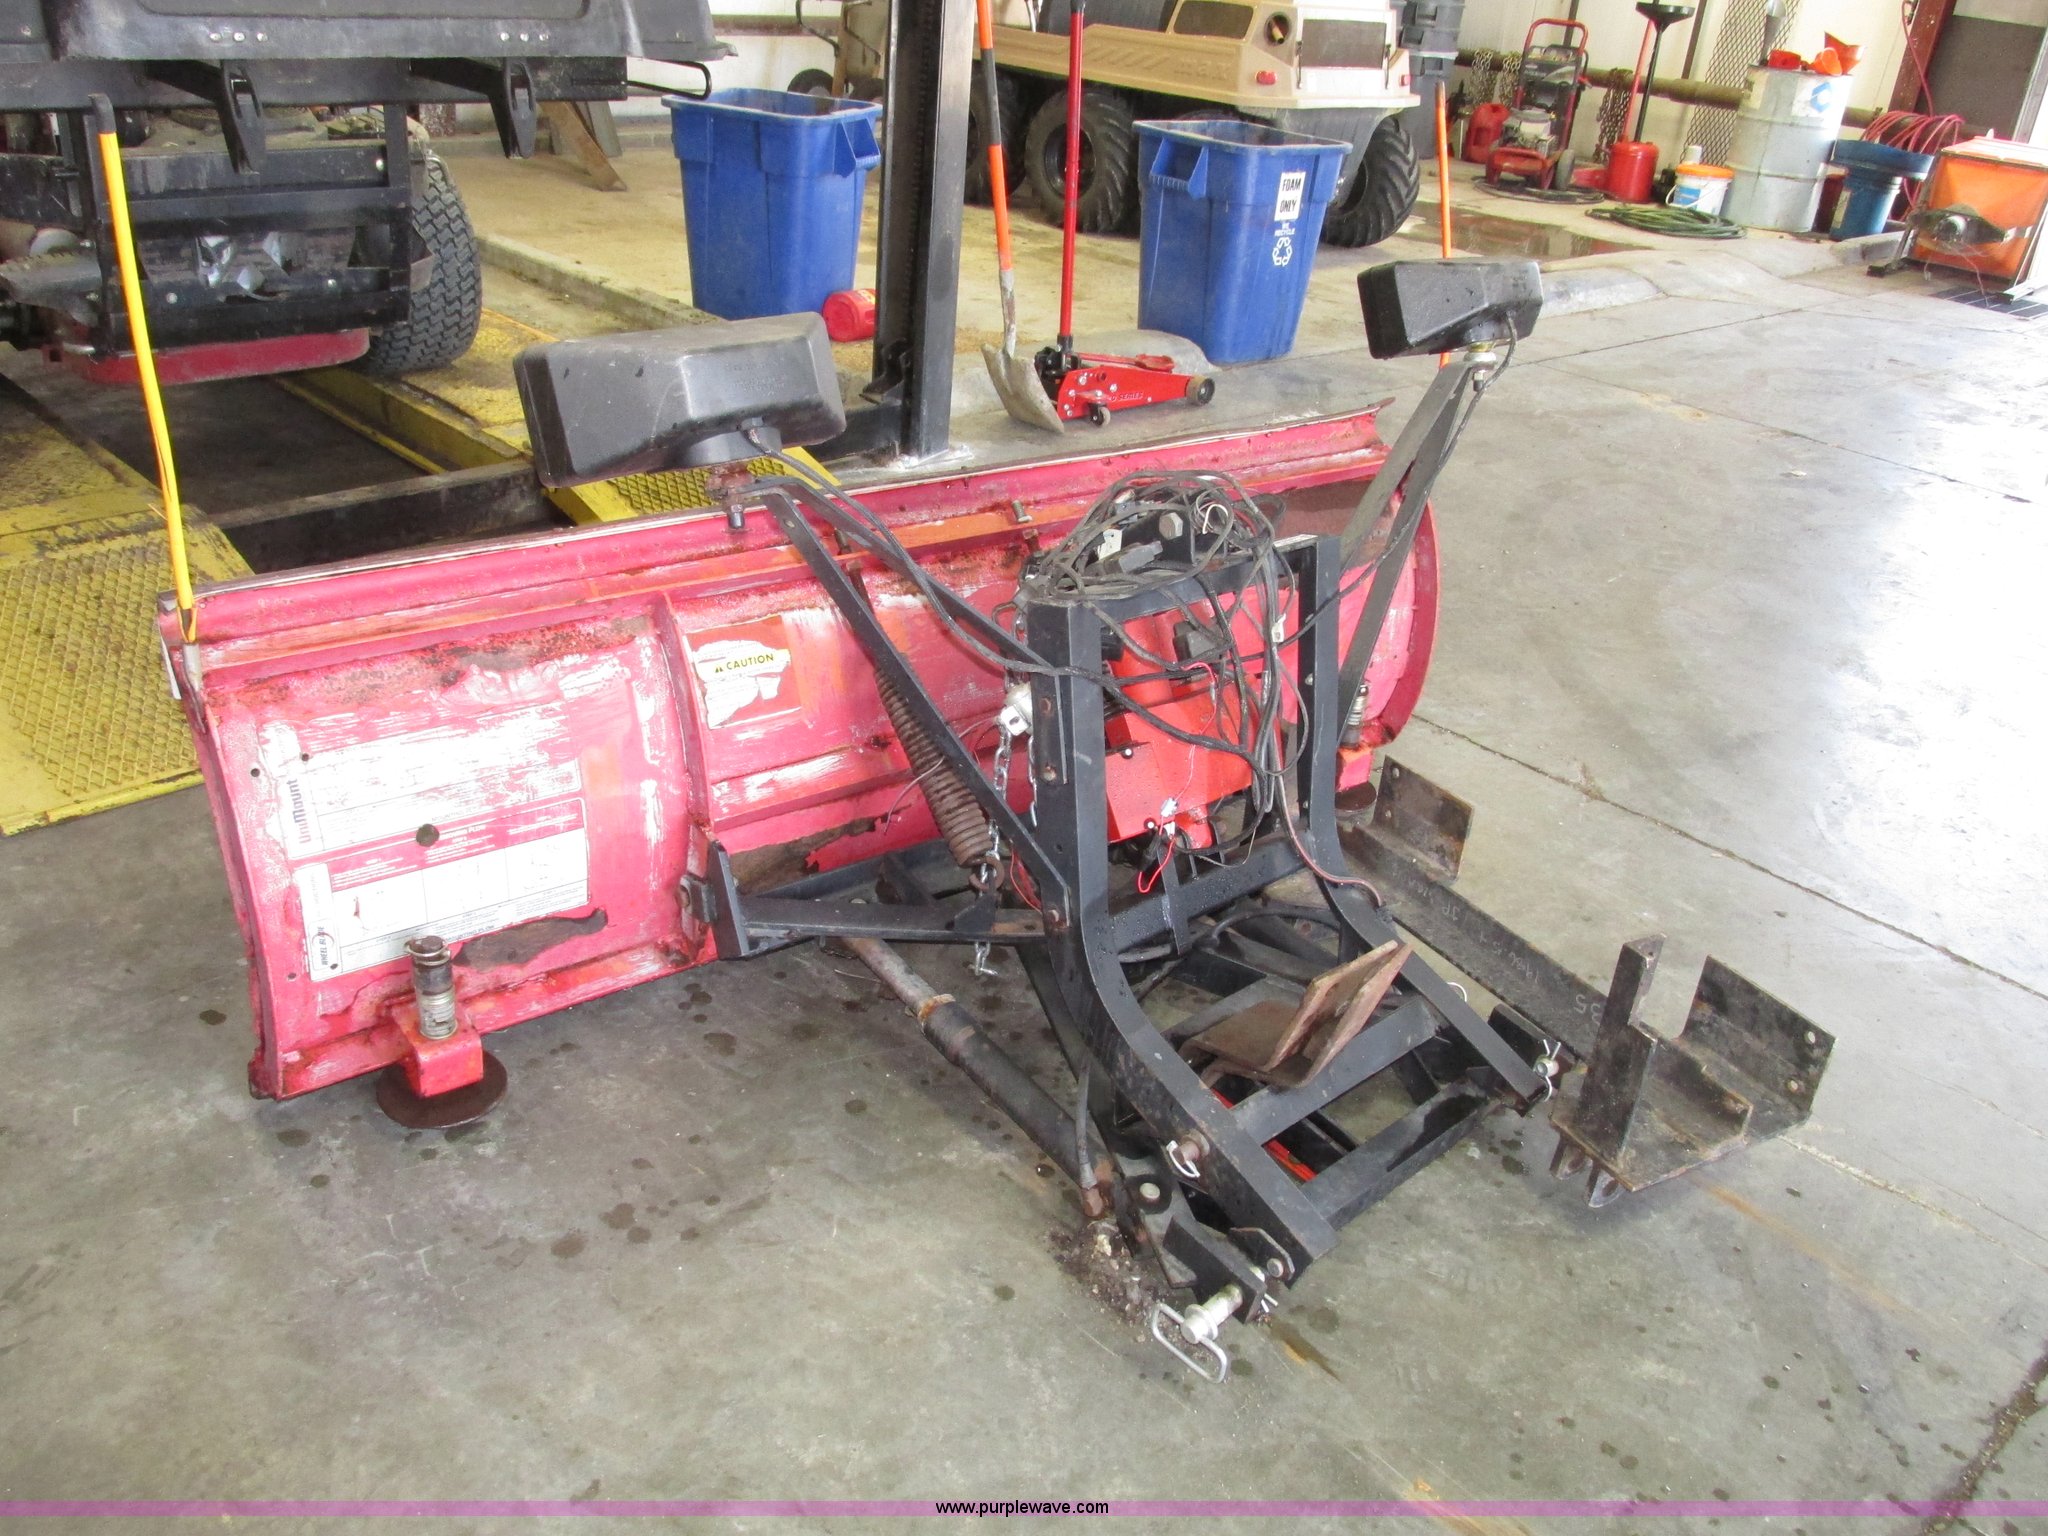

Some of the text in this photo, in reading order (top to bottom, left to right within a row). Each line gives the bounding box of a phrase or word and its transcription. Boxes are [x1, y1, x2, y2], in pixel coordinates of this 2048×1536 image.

[1281, 178, 1302, 191] FOAM
[1279, 199, 1297, 213] ONLY
[726, 653, 775, 671] CAUTION
[286, 778, 312, 844] UniMount
